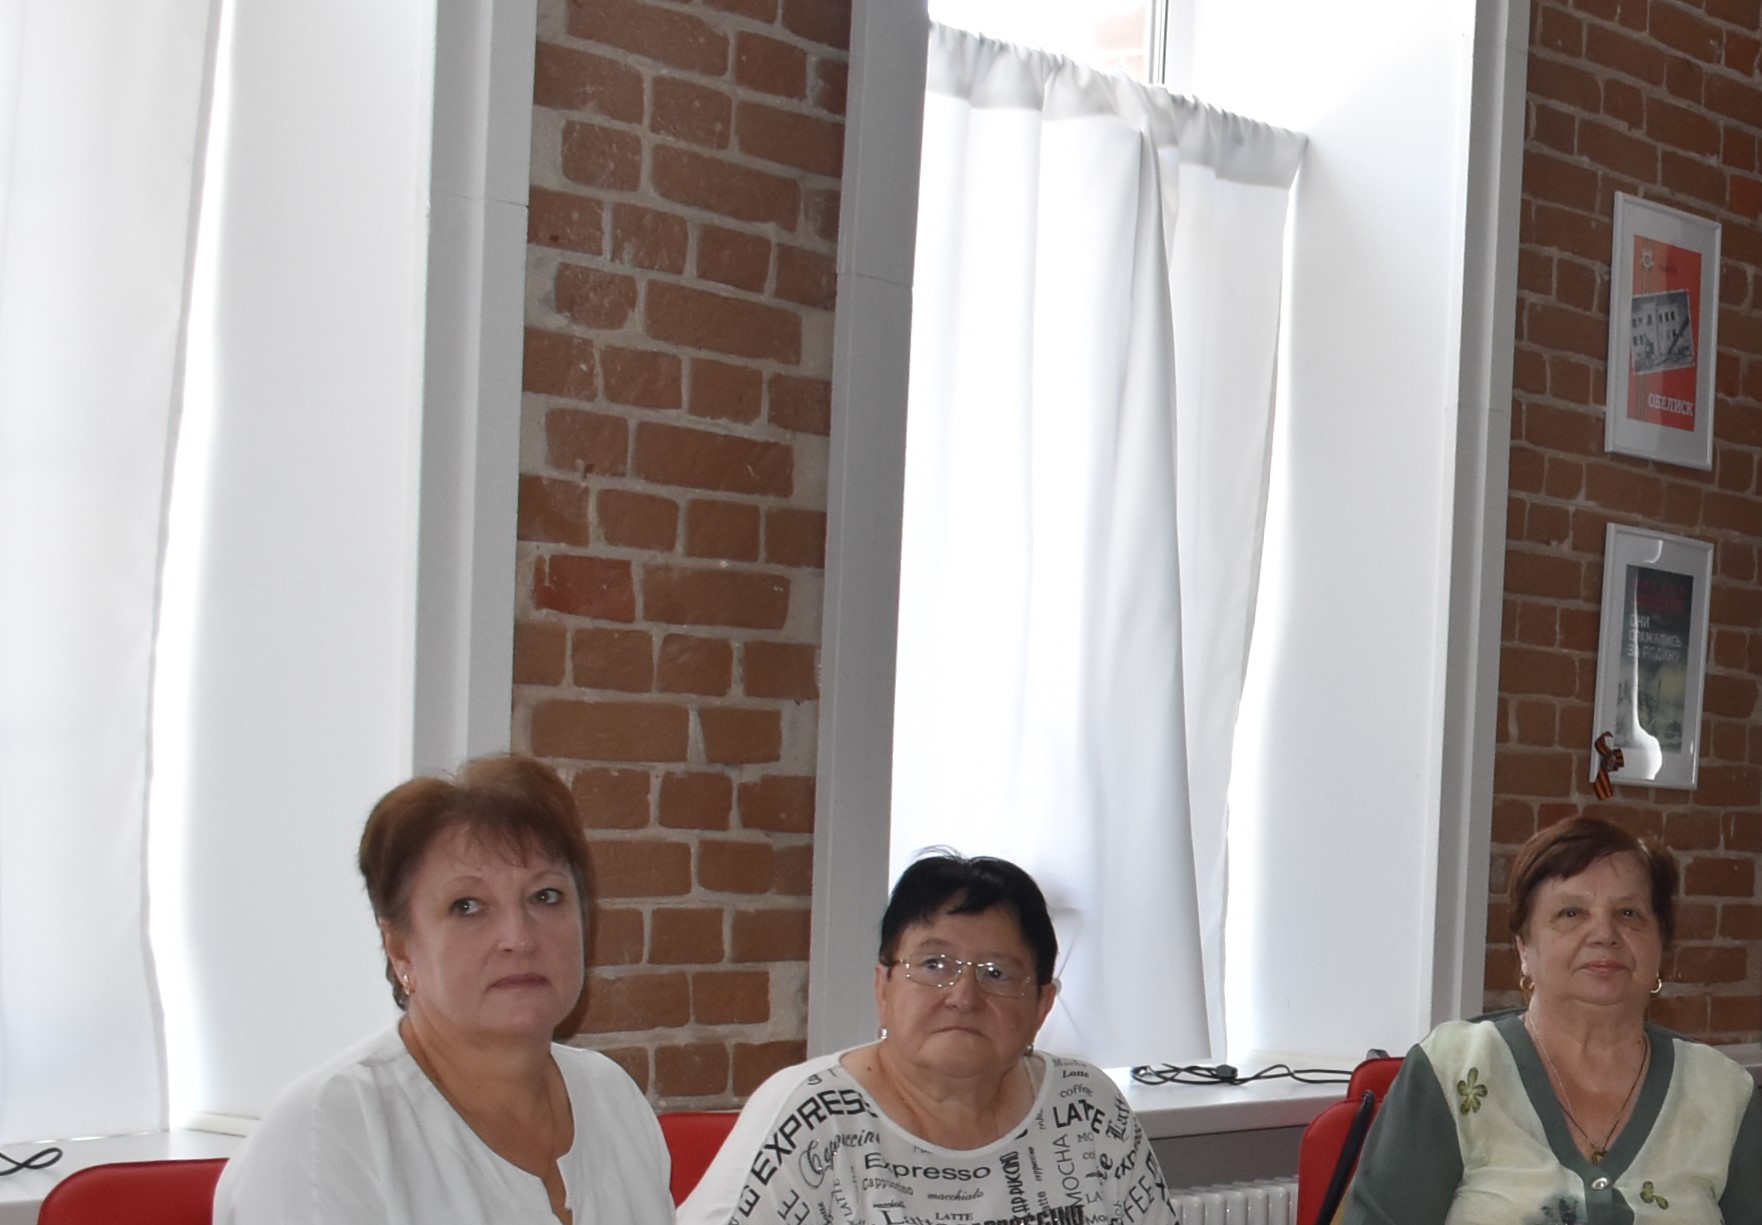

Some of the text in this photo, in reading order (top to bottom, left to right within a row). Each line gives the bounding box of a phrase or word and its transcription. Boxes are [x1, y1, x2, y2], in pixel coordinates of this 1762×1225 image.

[1648, 393, 1693, 416] ОБЕЛИСК
[927, 1188, 984, 1201] macchiato
[935, 1212, 973, 1221] LATTE
